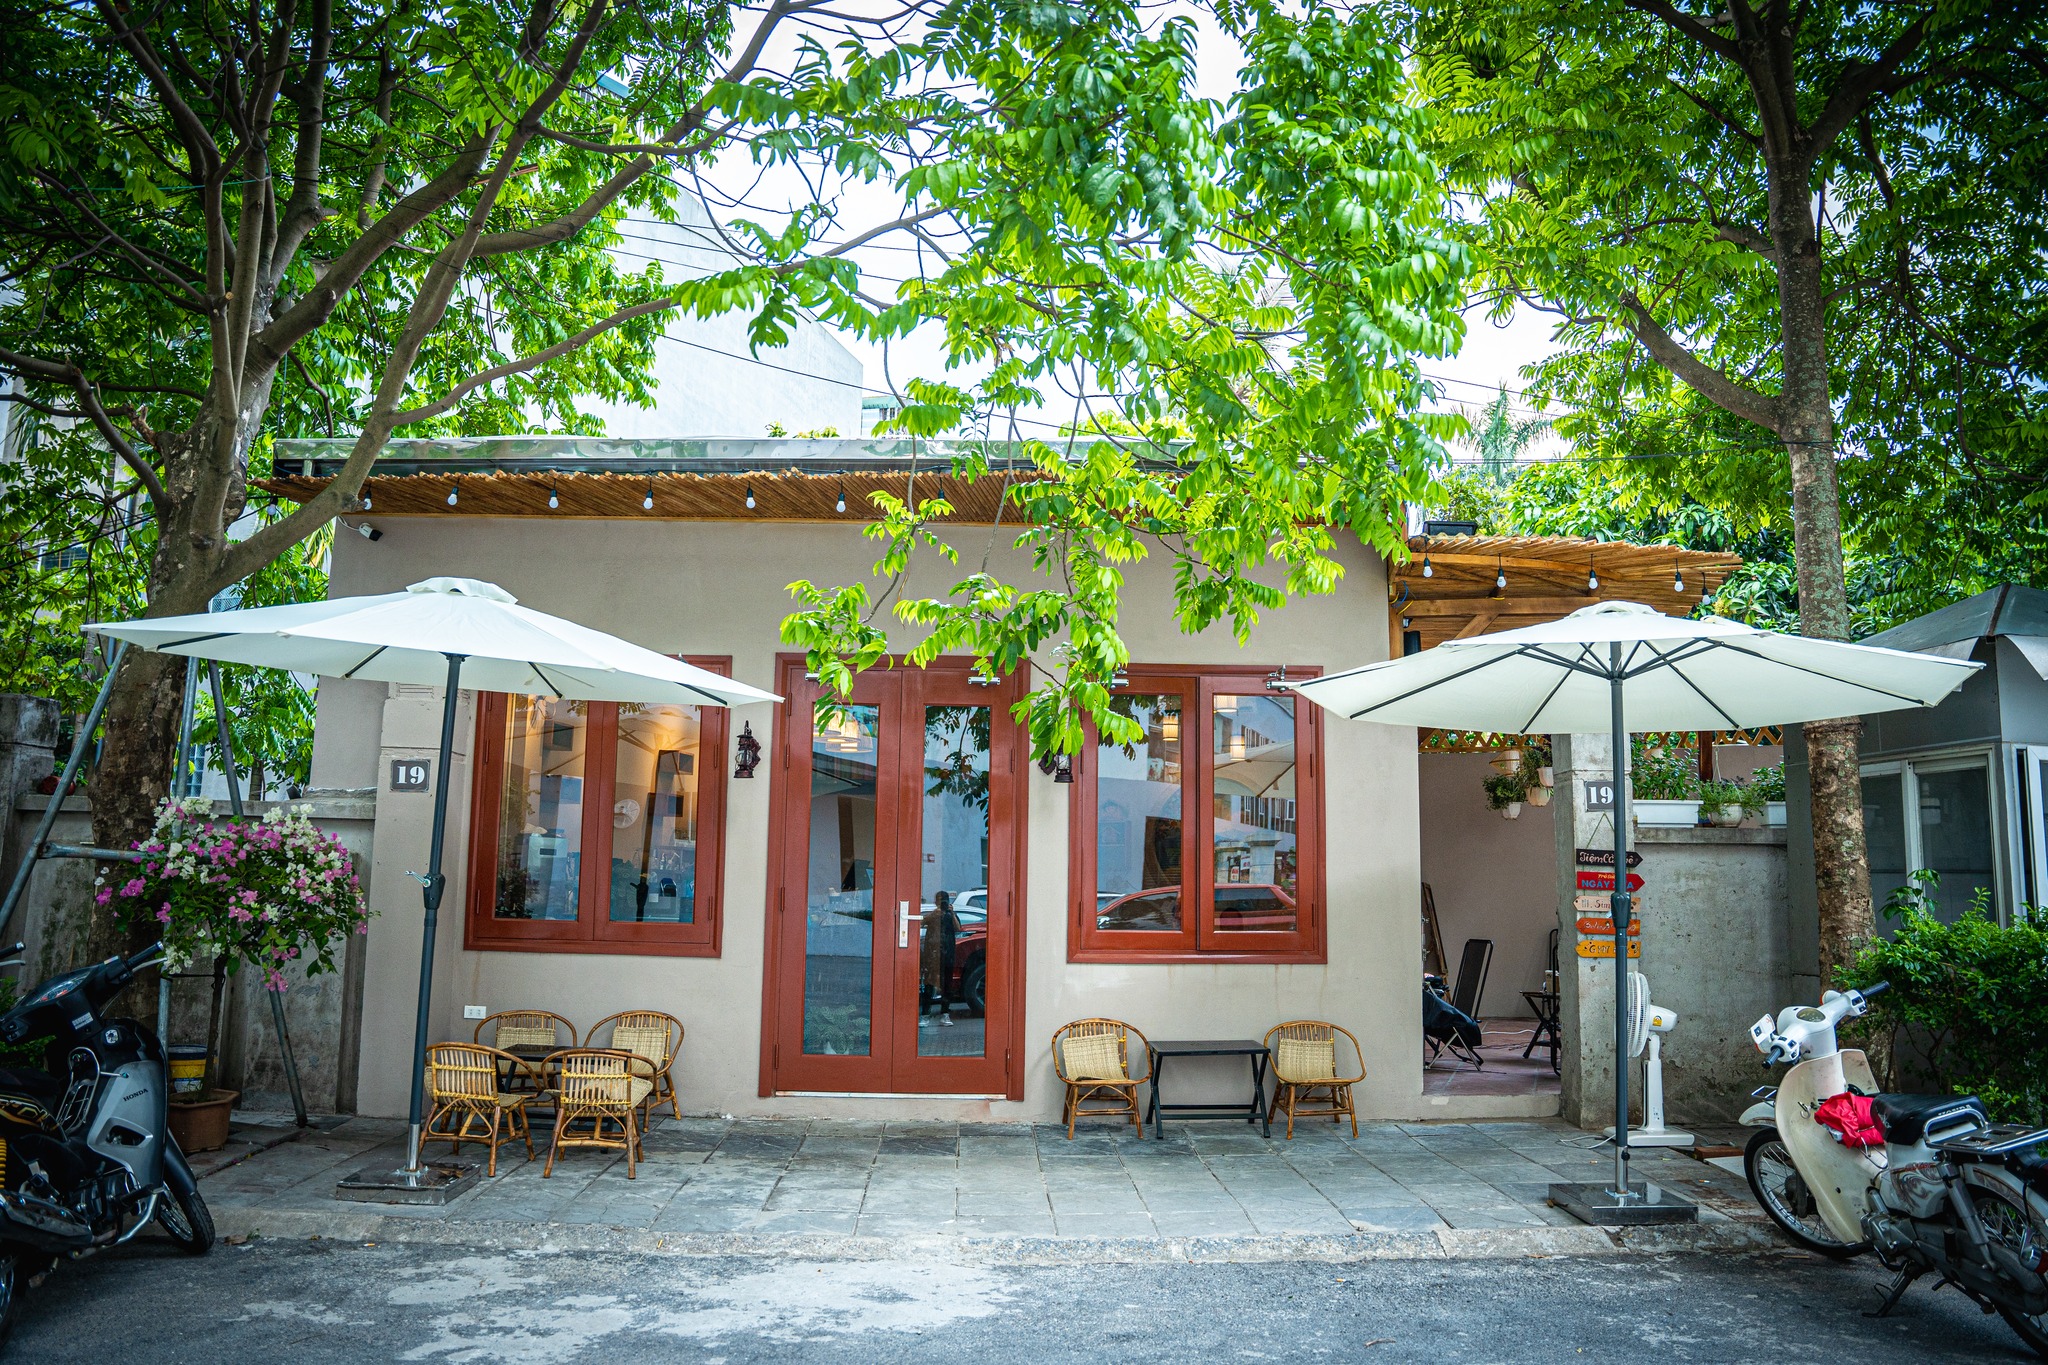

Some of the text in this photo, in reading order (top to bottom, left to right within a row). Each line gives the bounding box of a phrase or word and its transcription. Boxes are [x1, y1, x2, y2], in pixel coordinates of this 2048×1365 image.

[397, 765, 425, 785] 19
[1588, 786, 1614, 804] 19
[123, 1088, 149, 1102] HONDA
